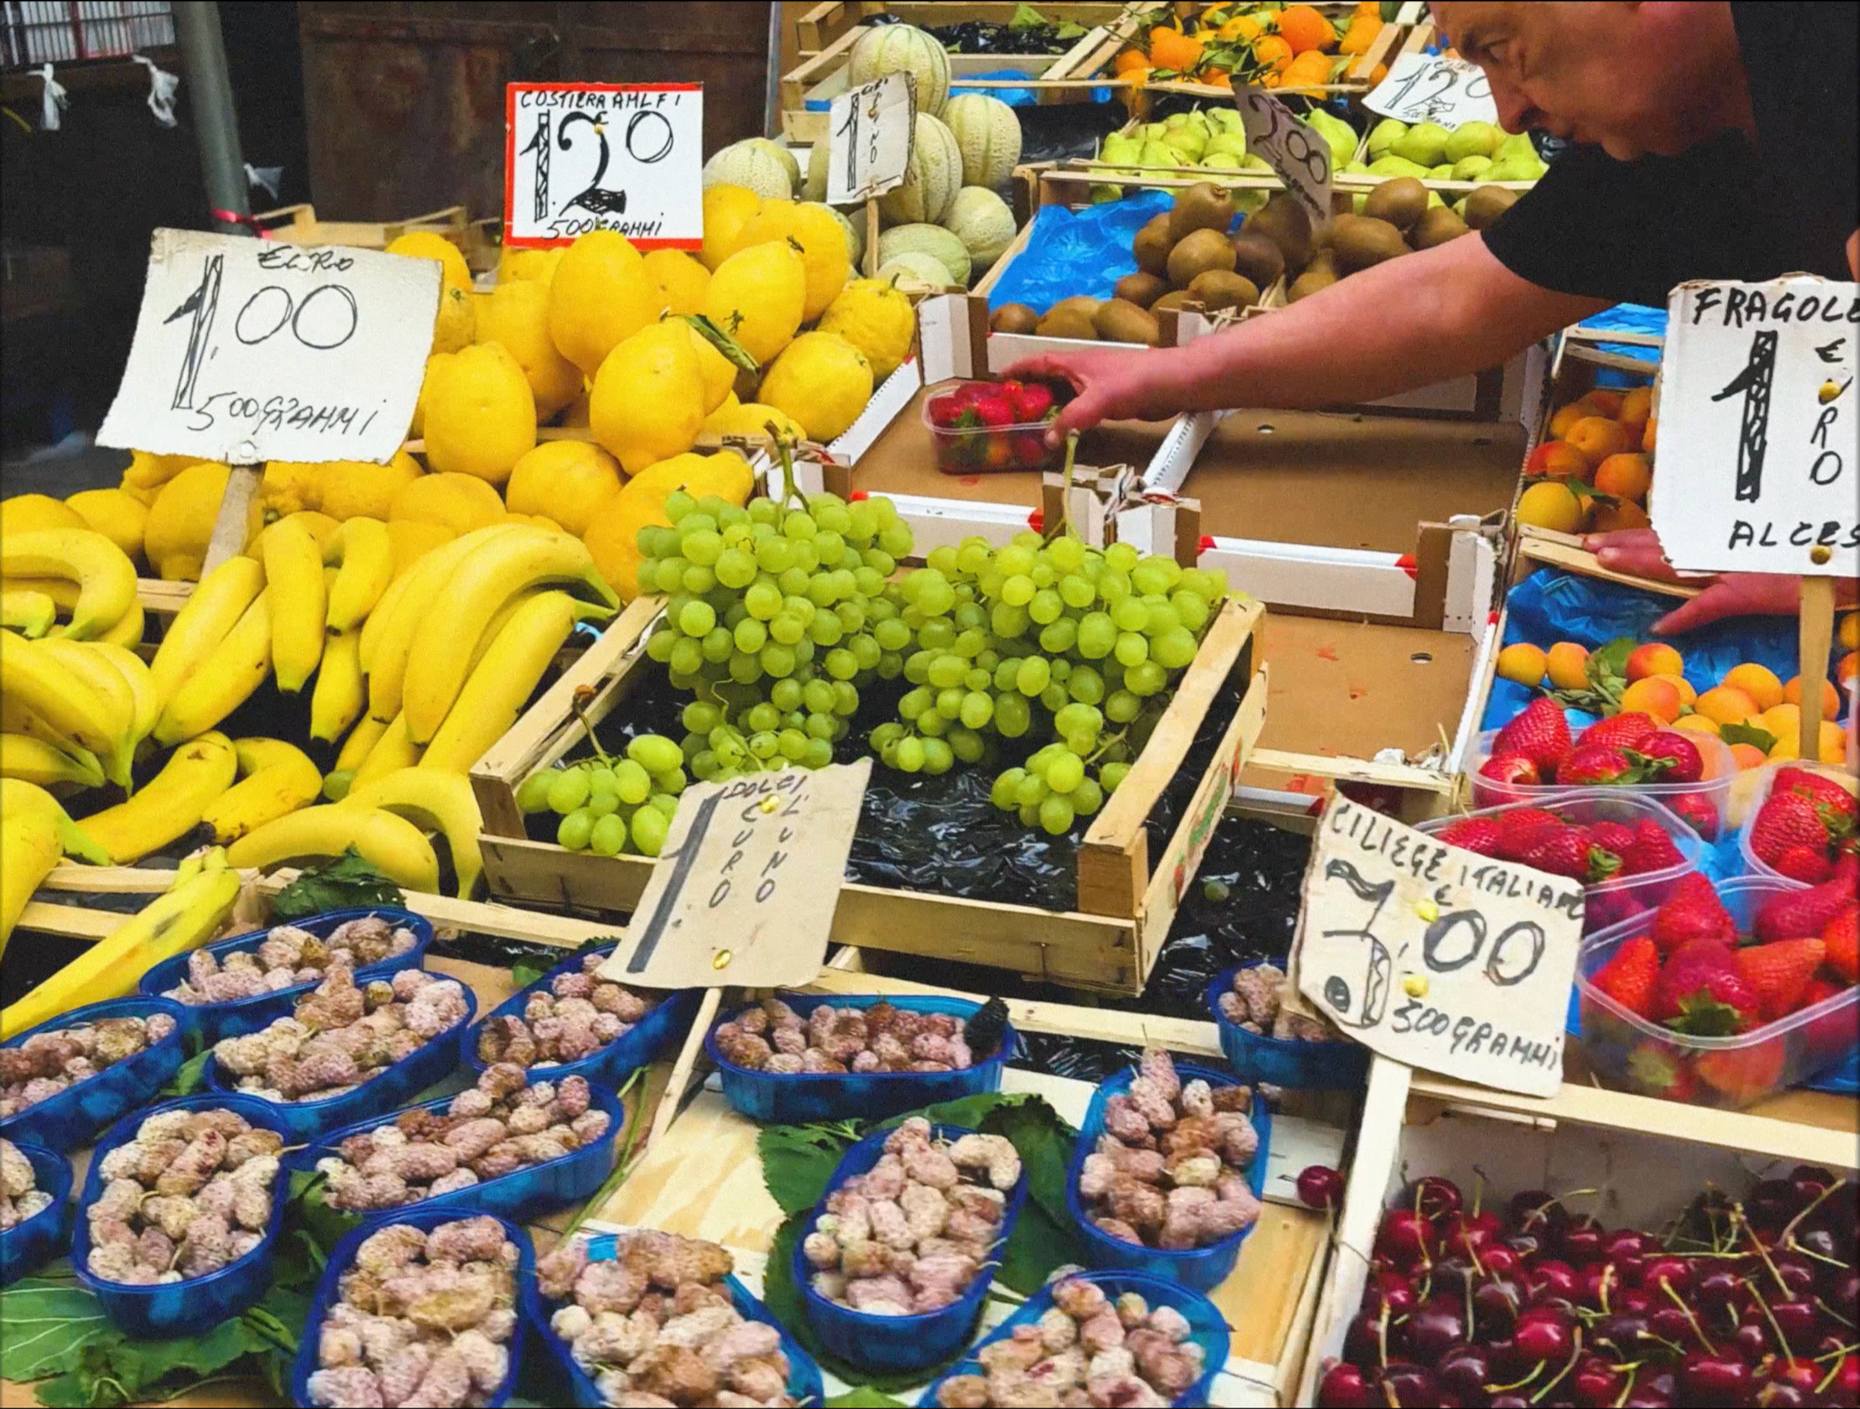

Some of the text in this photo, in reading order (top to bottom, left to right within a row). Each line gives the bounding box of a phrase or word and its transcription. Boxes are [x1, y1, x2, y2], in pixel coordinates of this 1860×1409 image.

[520, 91, 605, 108] COSTIERA
[837, 92, 860, 192] 1
[1711, 329, 1778, 503] 1
[626, 787, 729, 974] 1
